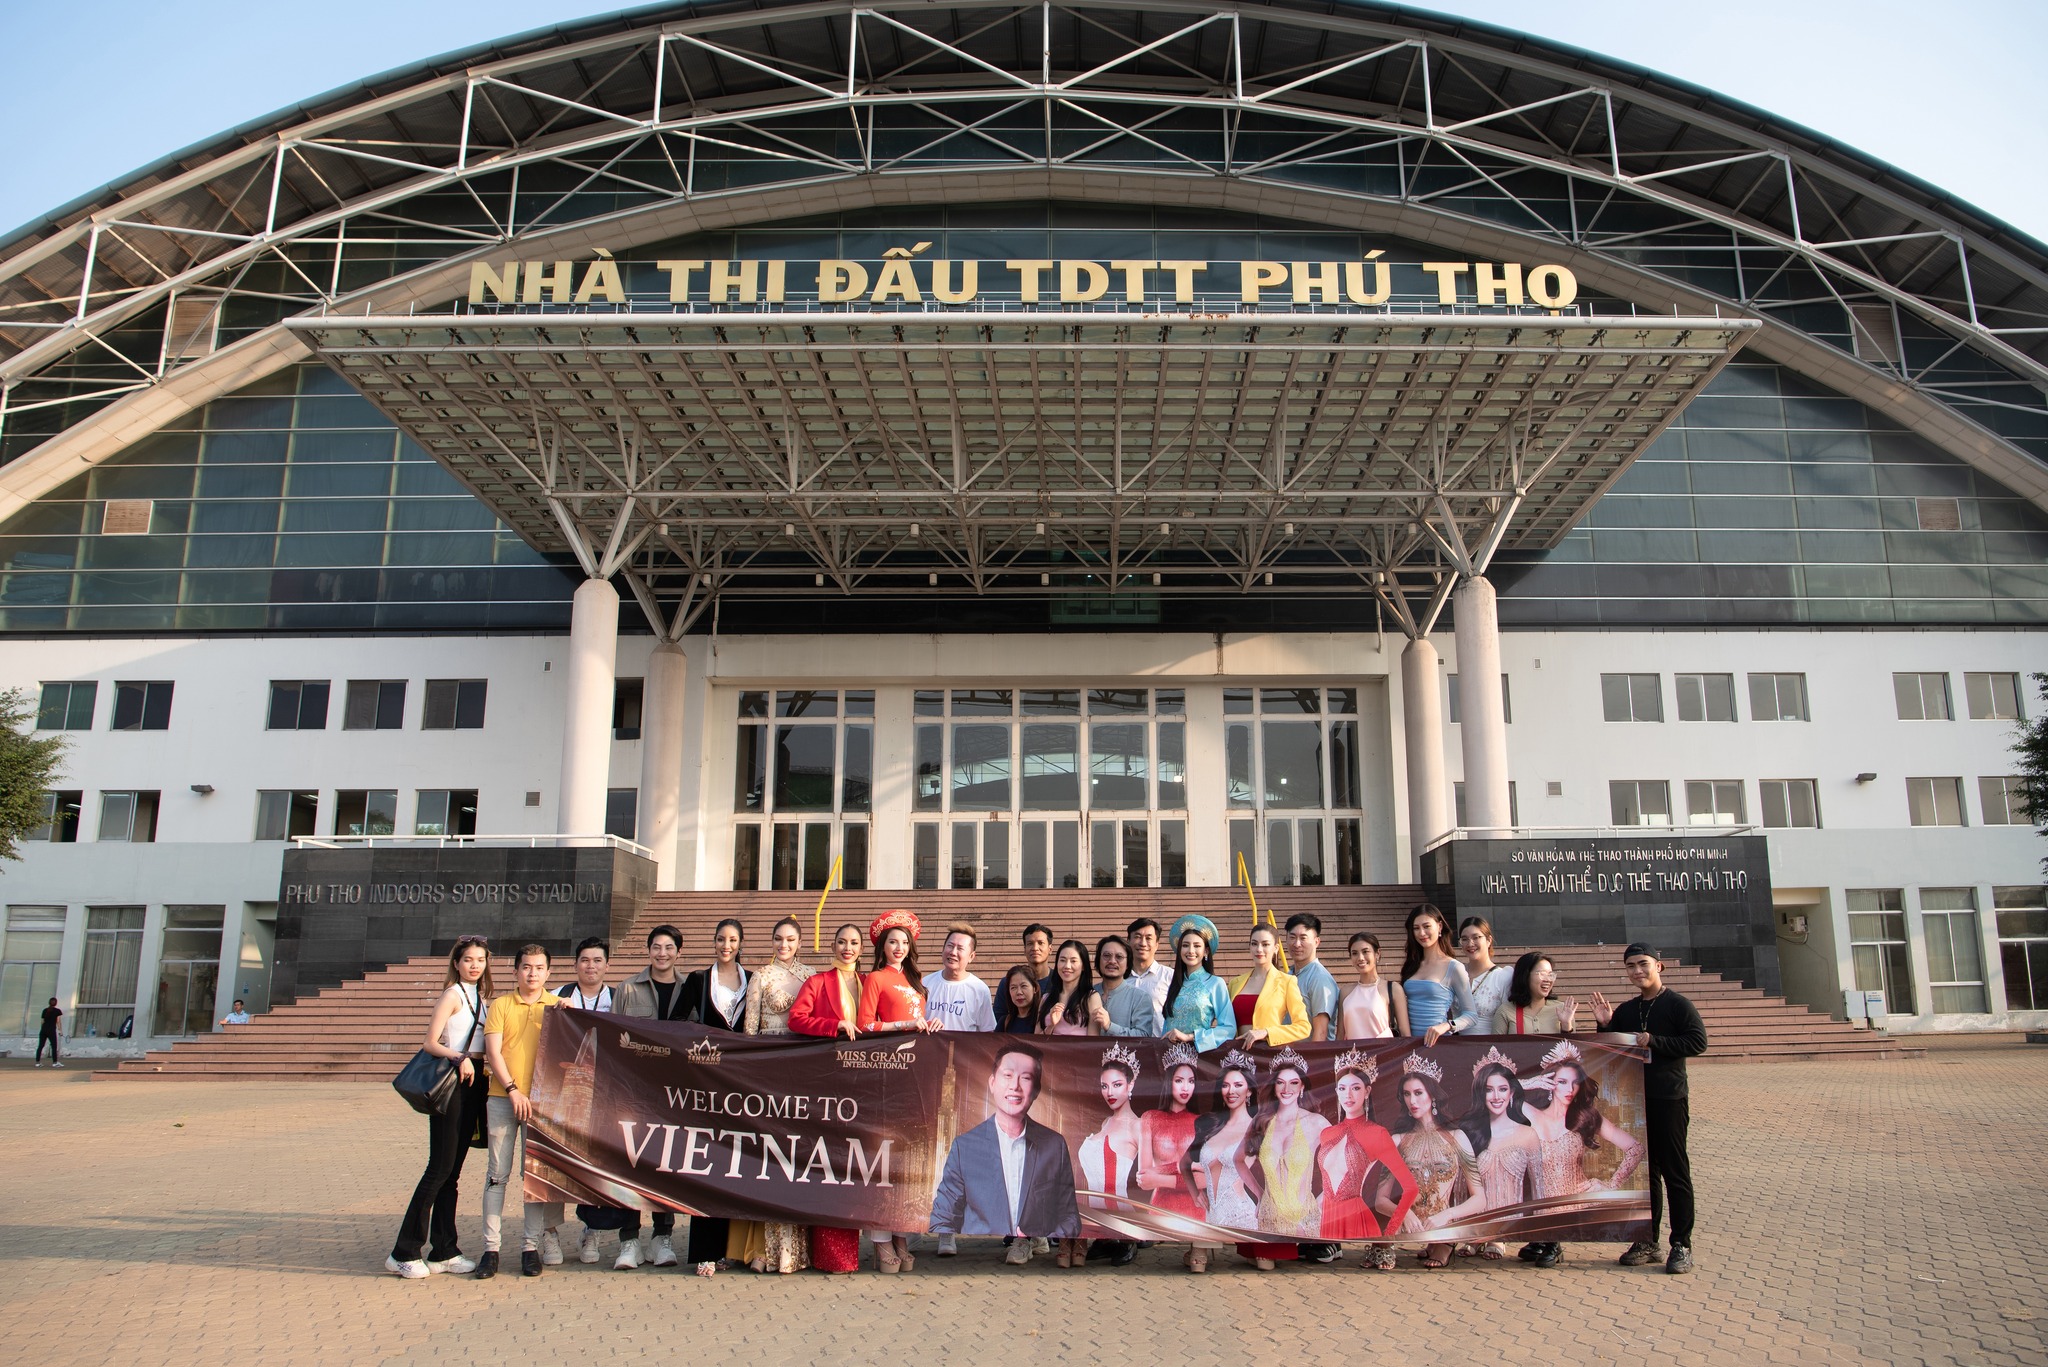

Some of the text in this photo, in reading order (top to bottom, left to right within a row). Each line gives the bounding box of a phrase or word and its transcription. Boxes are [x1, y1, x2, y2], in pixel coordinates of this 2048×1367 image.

[469, 241, 1578, 317] NHÀ THI ĐẤU TDTT PHÚ THỌ
[1597, 850, 1621, 861] THAO
[1623, 846, 1654, 861] THÀNH
[1655, 842, 1674, 861] PHỐ
[1706, 848, 1728, 860] MINH
[1480, 871, 1508, 894] NHÀ
[1511, 874, 1532, 894] THI
[1538, 866, 1564, 893] ĐẤU
[1566, 864, 1592, 893] THỂ
[1656, 871, 1690, 891] THAO
[1694, 866, 1719, 891] PHÚ
[1722, 869, 1748, 894] THỌ
[285, 883, 605, 904] PHU THO INDOORS SPORTS STADIUM
[836, 1050, 916, 1064] MISS GRAND
[842, 1060, 909, 1070] INTERNATIONAL
[664, 1085, 858, 1122] WELCOME TO
[618, 1120, 895, 1188] VIETNAM
